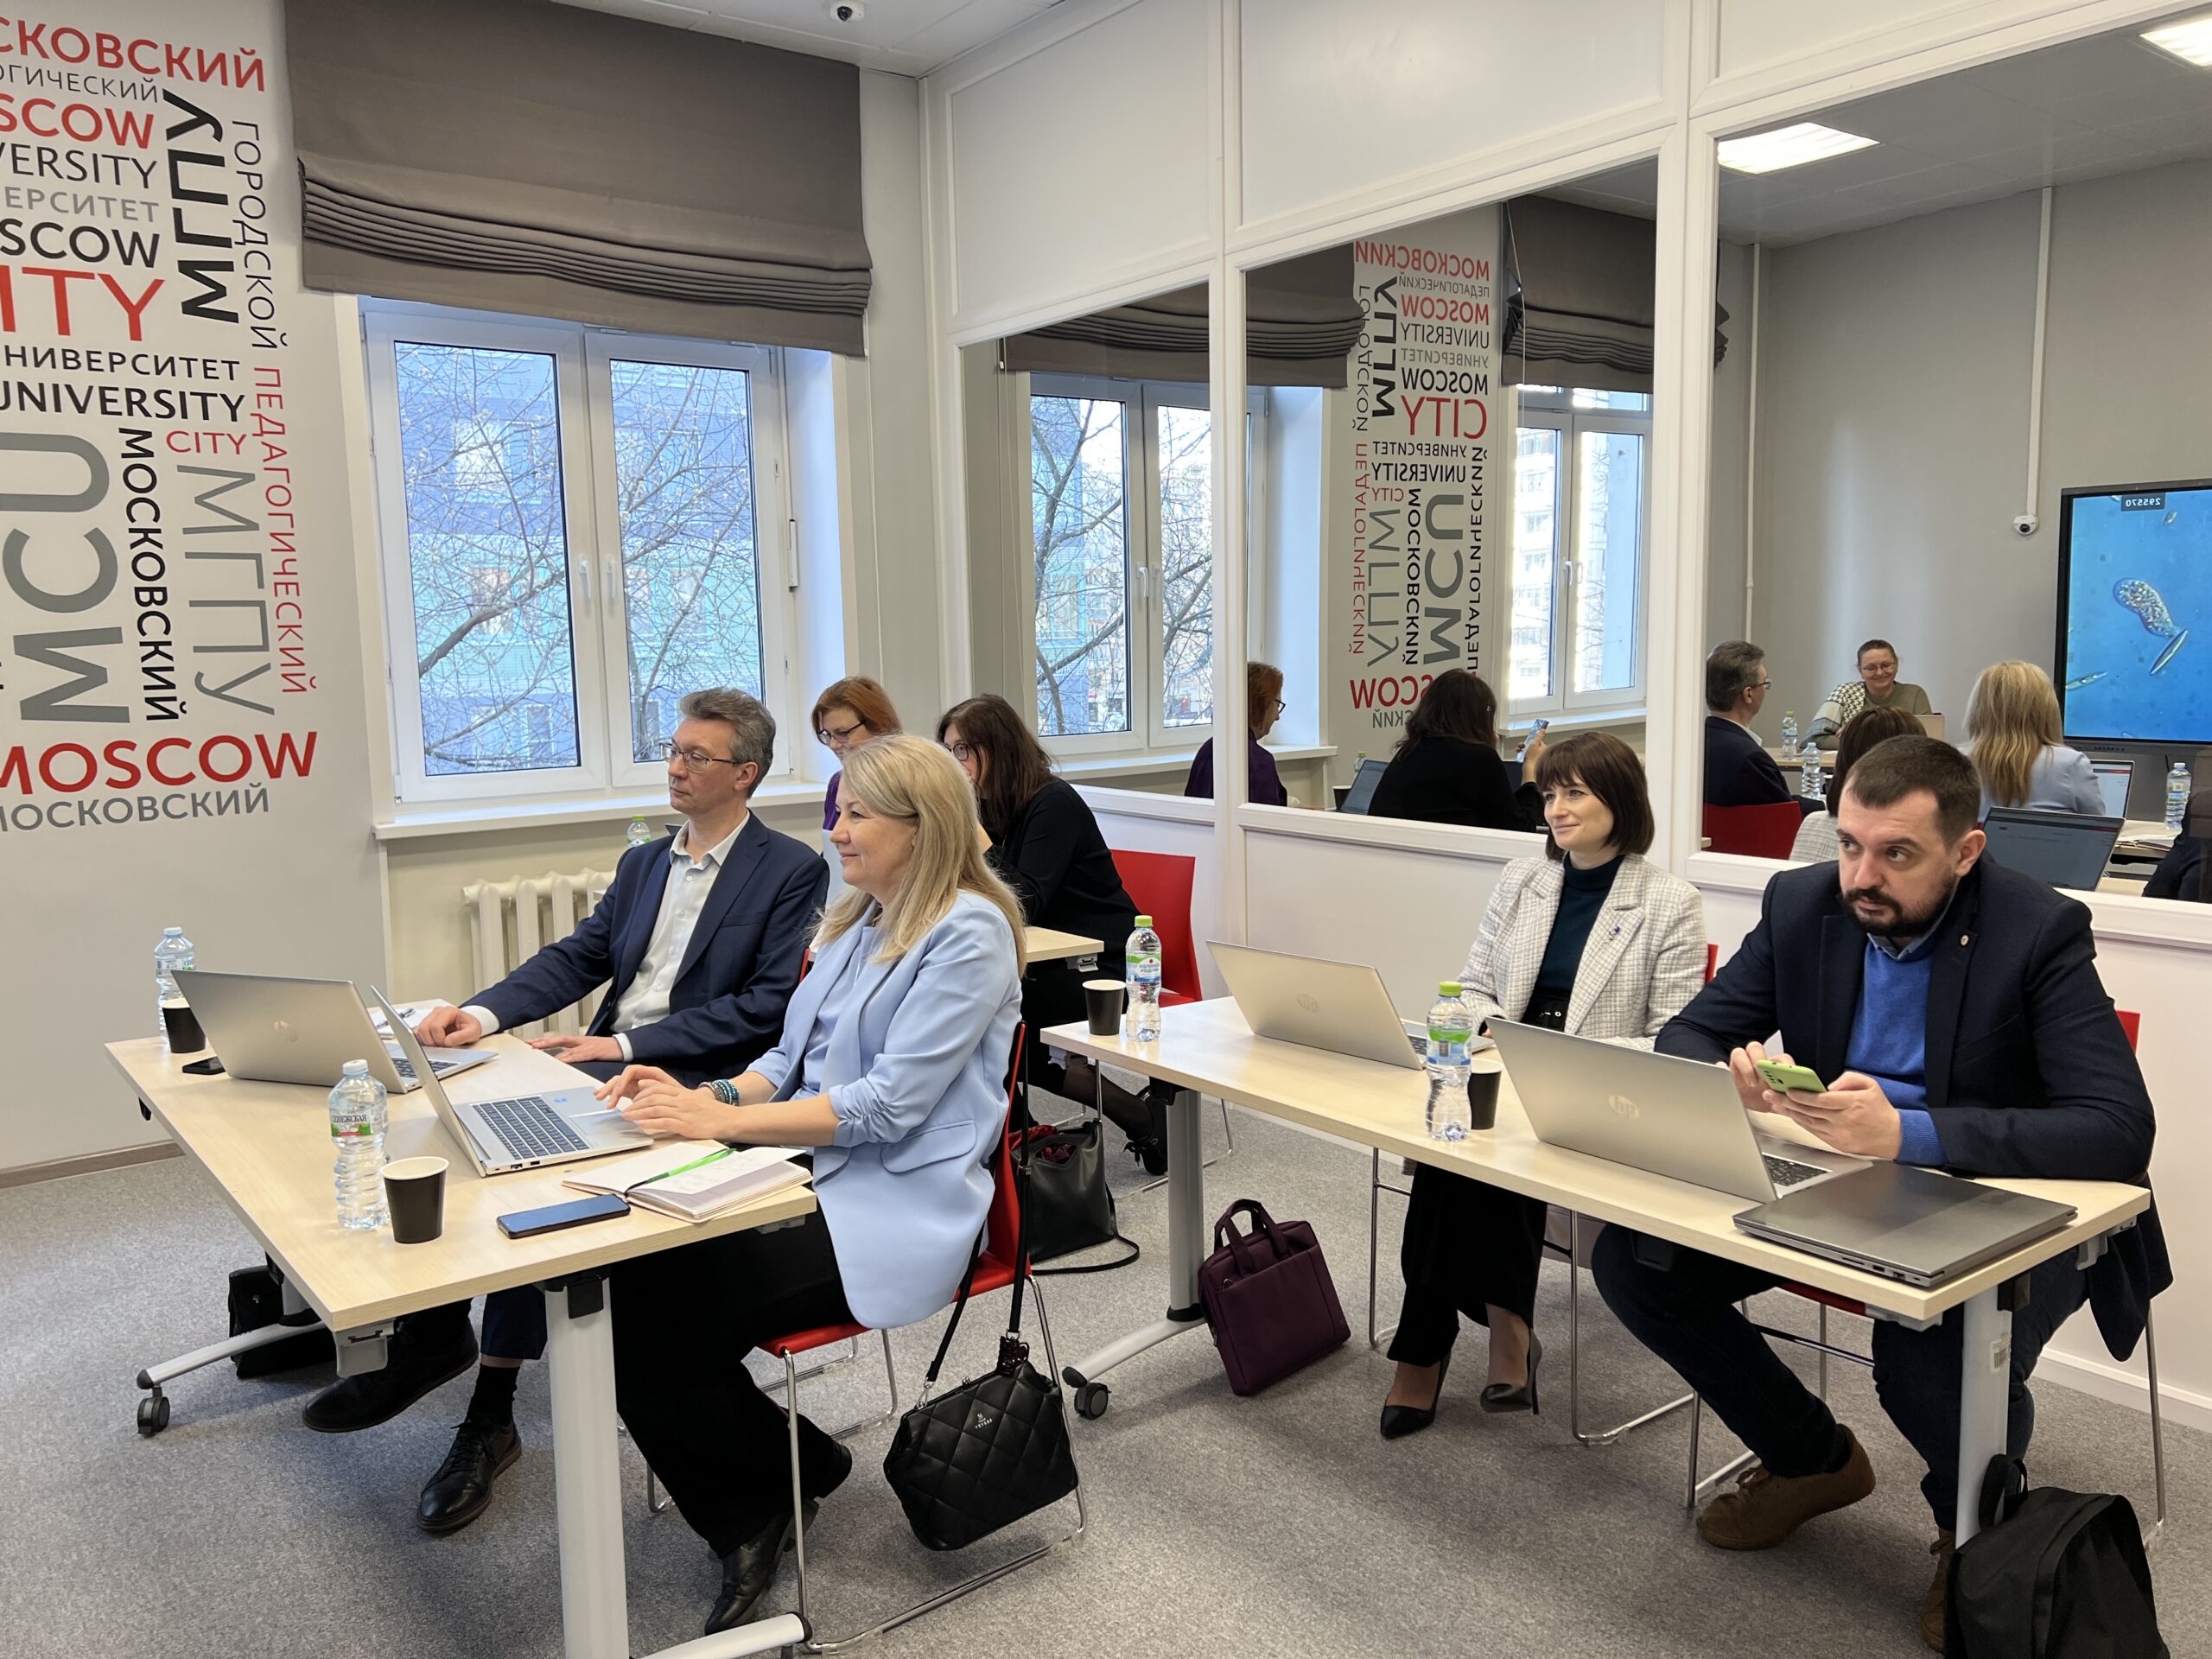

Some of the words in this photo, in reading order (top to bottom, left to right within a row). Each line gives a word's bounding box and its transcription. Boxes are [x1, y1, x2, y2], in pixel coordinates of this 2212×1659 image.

[0, 64, 157, 103] ГИЧЕСКИЙ
[0, 143, 156, 188] ERSITY
[162, 88, 239, 323] МГПУ
[232, 121, 287, 348] ГОРОДСКОЙ
[4, 345, 239, 380] НИВЕРСИТЕТ
[166, 430, 247, 454] CITY
[0, 432, 130, 723] MCU
[118, 428, 187, 721] МОСКОВСКИЙ
[177, 465, 275, 715] МГПУ
[250, 367, 316, 692] ПЕДАГОГИЧЕСКИЙ
[0, 782, 269, 832] ОСКОВСКИЙ
